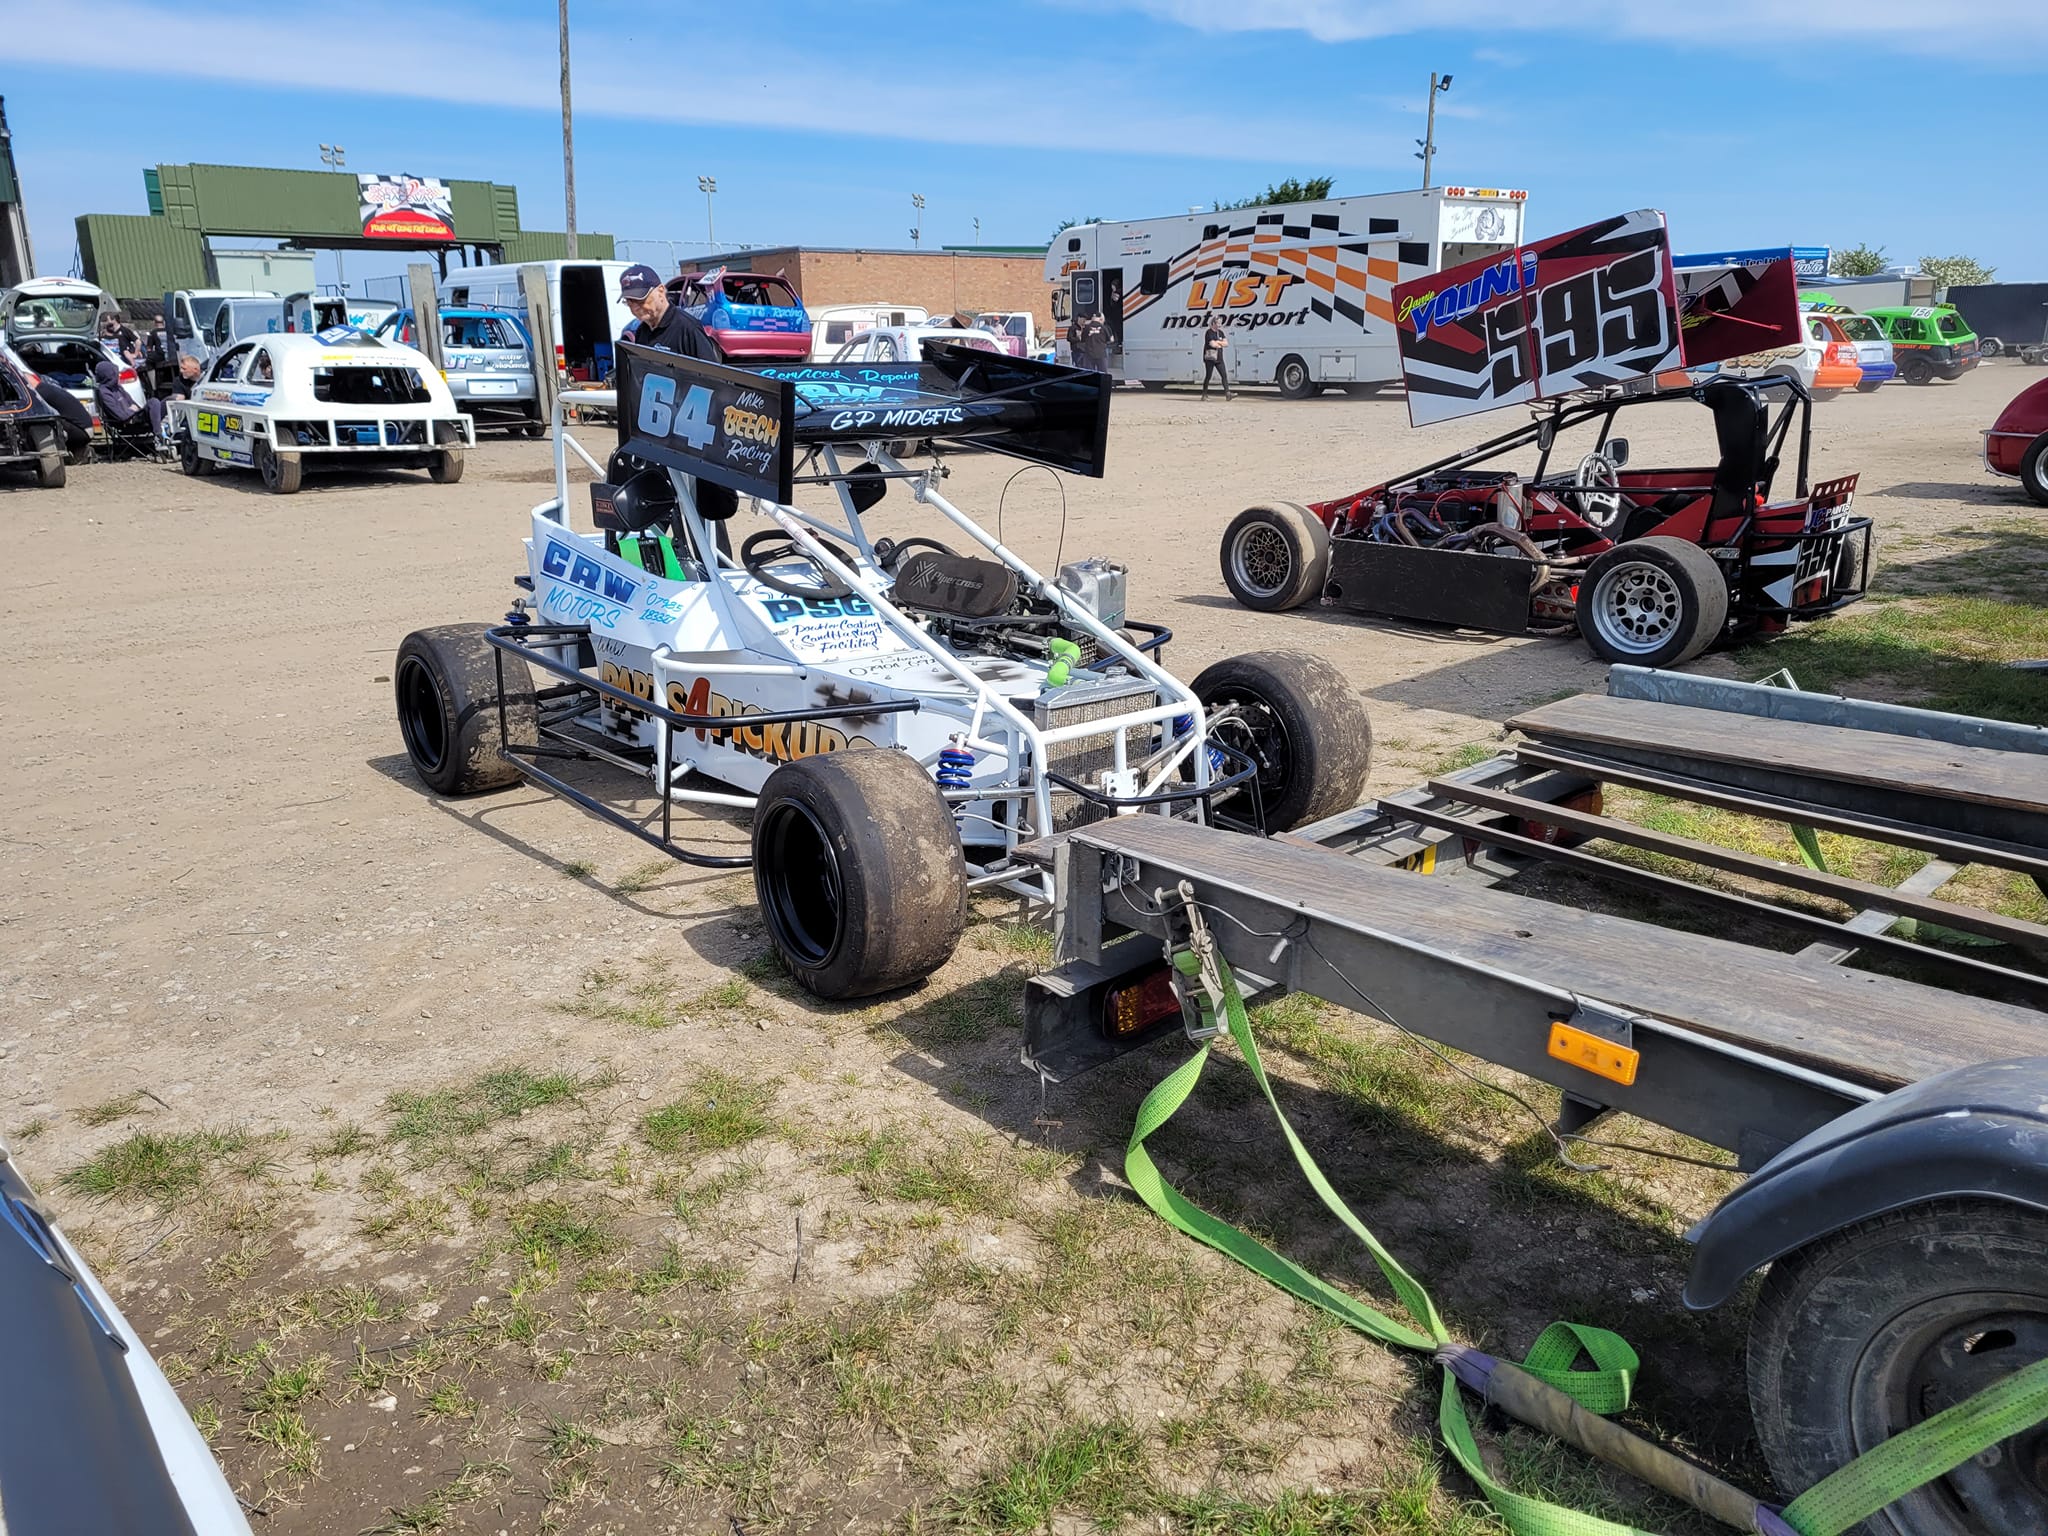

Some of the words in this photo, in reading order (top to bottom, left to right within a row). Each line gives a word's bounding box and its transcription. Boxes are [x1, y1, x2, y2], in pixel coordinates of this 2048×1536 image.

[1219, 265, 1250, 283] Team
[1186, 274, 1293, 310] LIST
[1397, 290, 1436, 322] Jamie
[1410, 251, 1538, 343] YOUNG
[1484, 245, 1669, 399] 595
[1913, 307, 1933, 318] 156
[760, 368, 850, 382] Services
[858, 369, 924, 384] Repairs
[637, 372, 717, 450] 64
[735, 390, 766, 410] Mike
[197, 412, 219, 434] 21
[723, 405, 781, 448] BEECH
[831, 410, 875, 431] GP
[881, 406, 964, 428] MIDGETS
[726, 439, 773, 474] Racing
[542, 540, 637, 604] CRW
[930, 571, 983, 590] Pipercross
[544, 585, 622, 629] MOTORS
[759, 594, 875, 624] PSG
[840, 619, 882, 634] Coating
